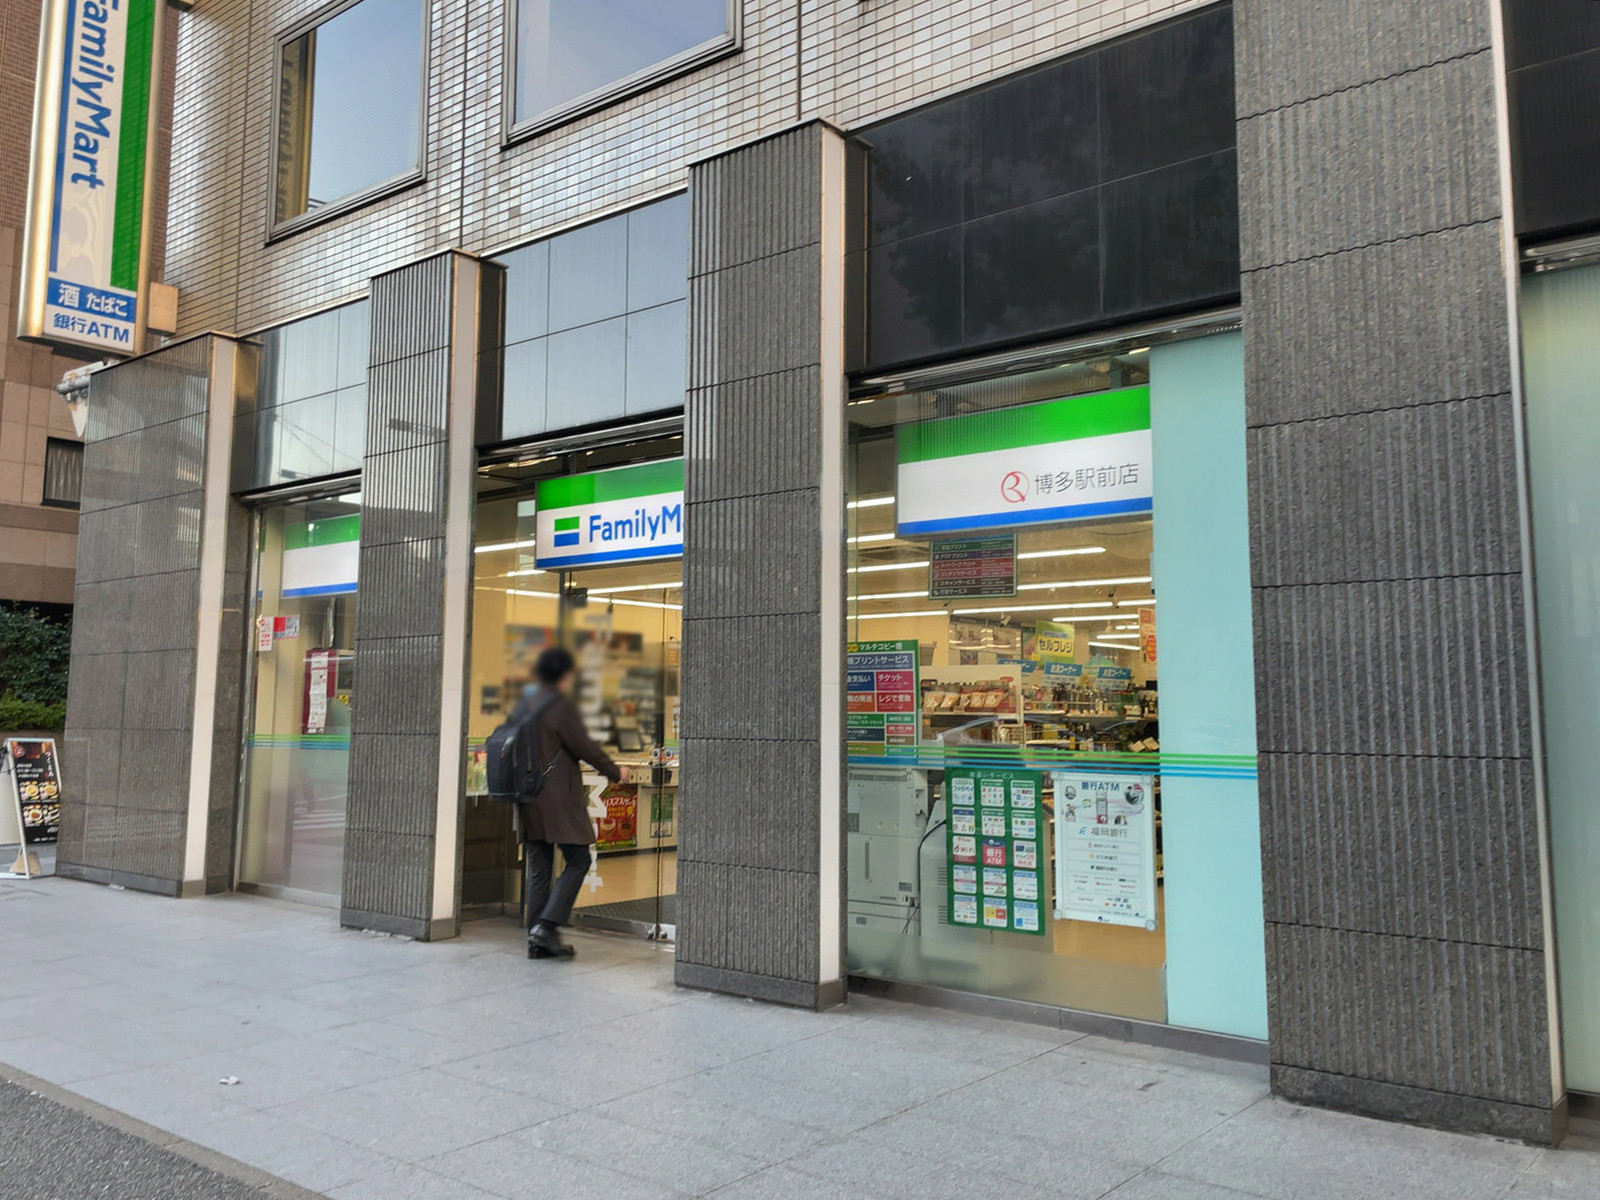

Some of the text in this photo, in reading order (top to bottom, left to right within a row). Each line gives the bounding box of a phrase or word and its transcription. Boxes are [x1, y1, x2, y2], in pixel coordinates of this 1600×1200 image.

[57, 282, 128, 318] 酒 たばこ
[53, 312, 129, 344] 銀行ATM
[1034, 462, 1139, 496] 博多駅前店
[589, 503, 681, 543] FamilyM
